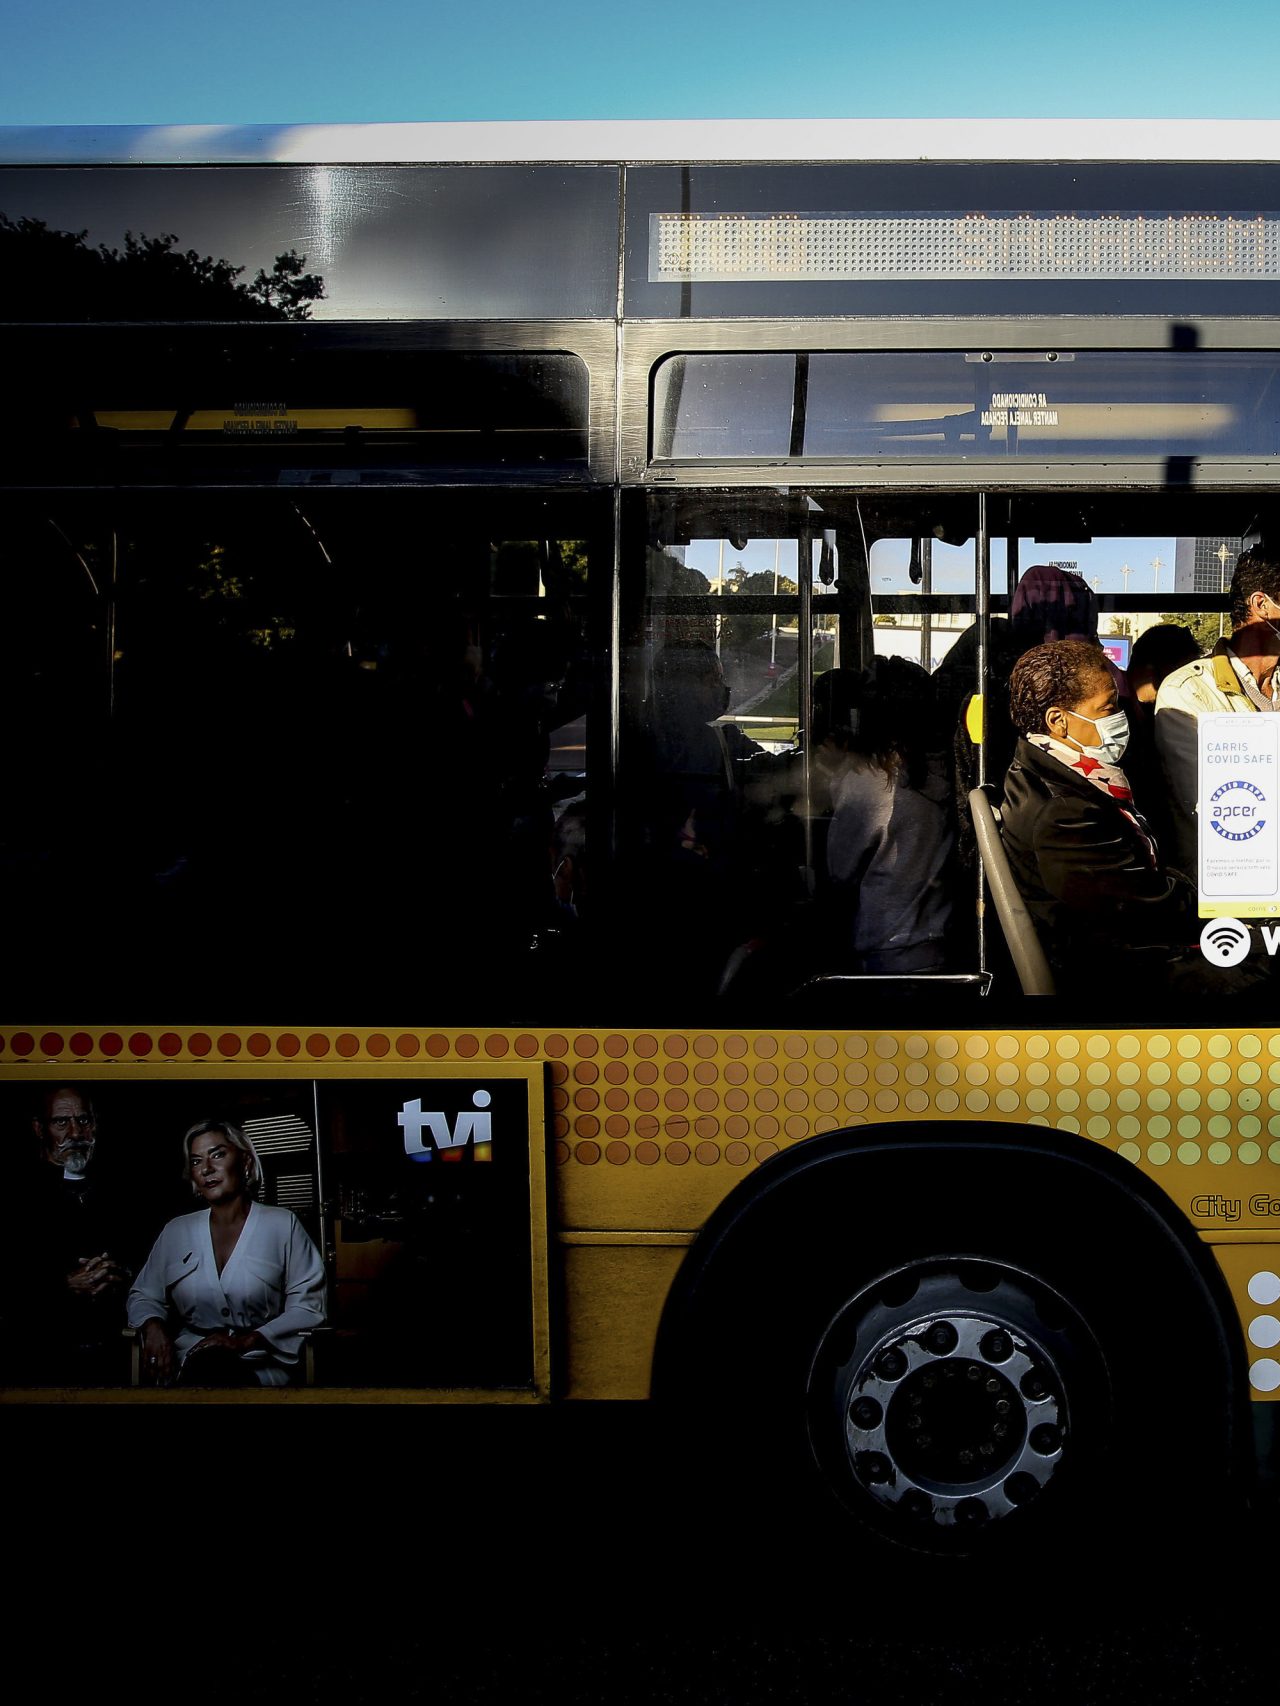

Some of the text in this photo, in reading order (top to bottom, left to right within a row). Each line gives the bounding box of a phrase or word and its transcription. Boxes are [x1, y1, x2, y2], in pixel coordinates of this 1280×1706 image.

[1207, 742, 1248, 752] CARRIS
[1207, 754, 1273, 764] COVID SAFE
[1213, 782, 1237, 800] COVID
[1213, 806, 1257, 821] apcer
[398, 1089, 492, 1157] tvi
[1191, 1195, 1241, 1222] City
